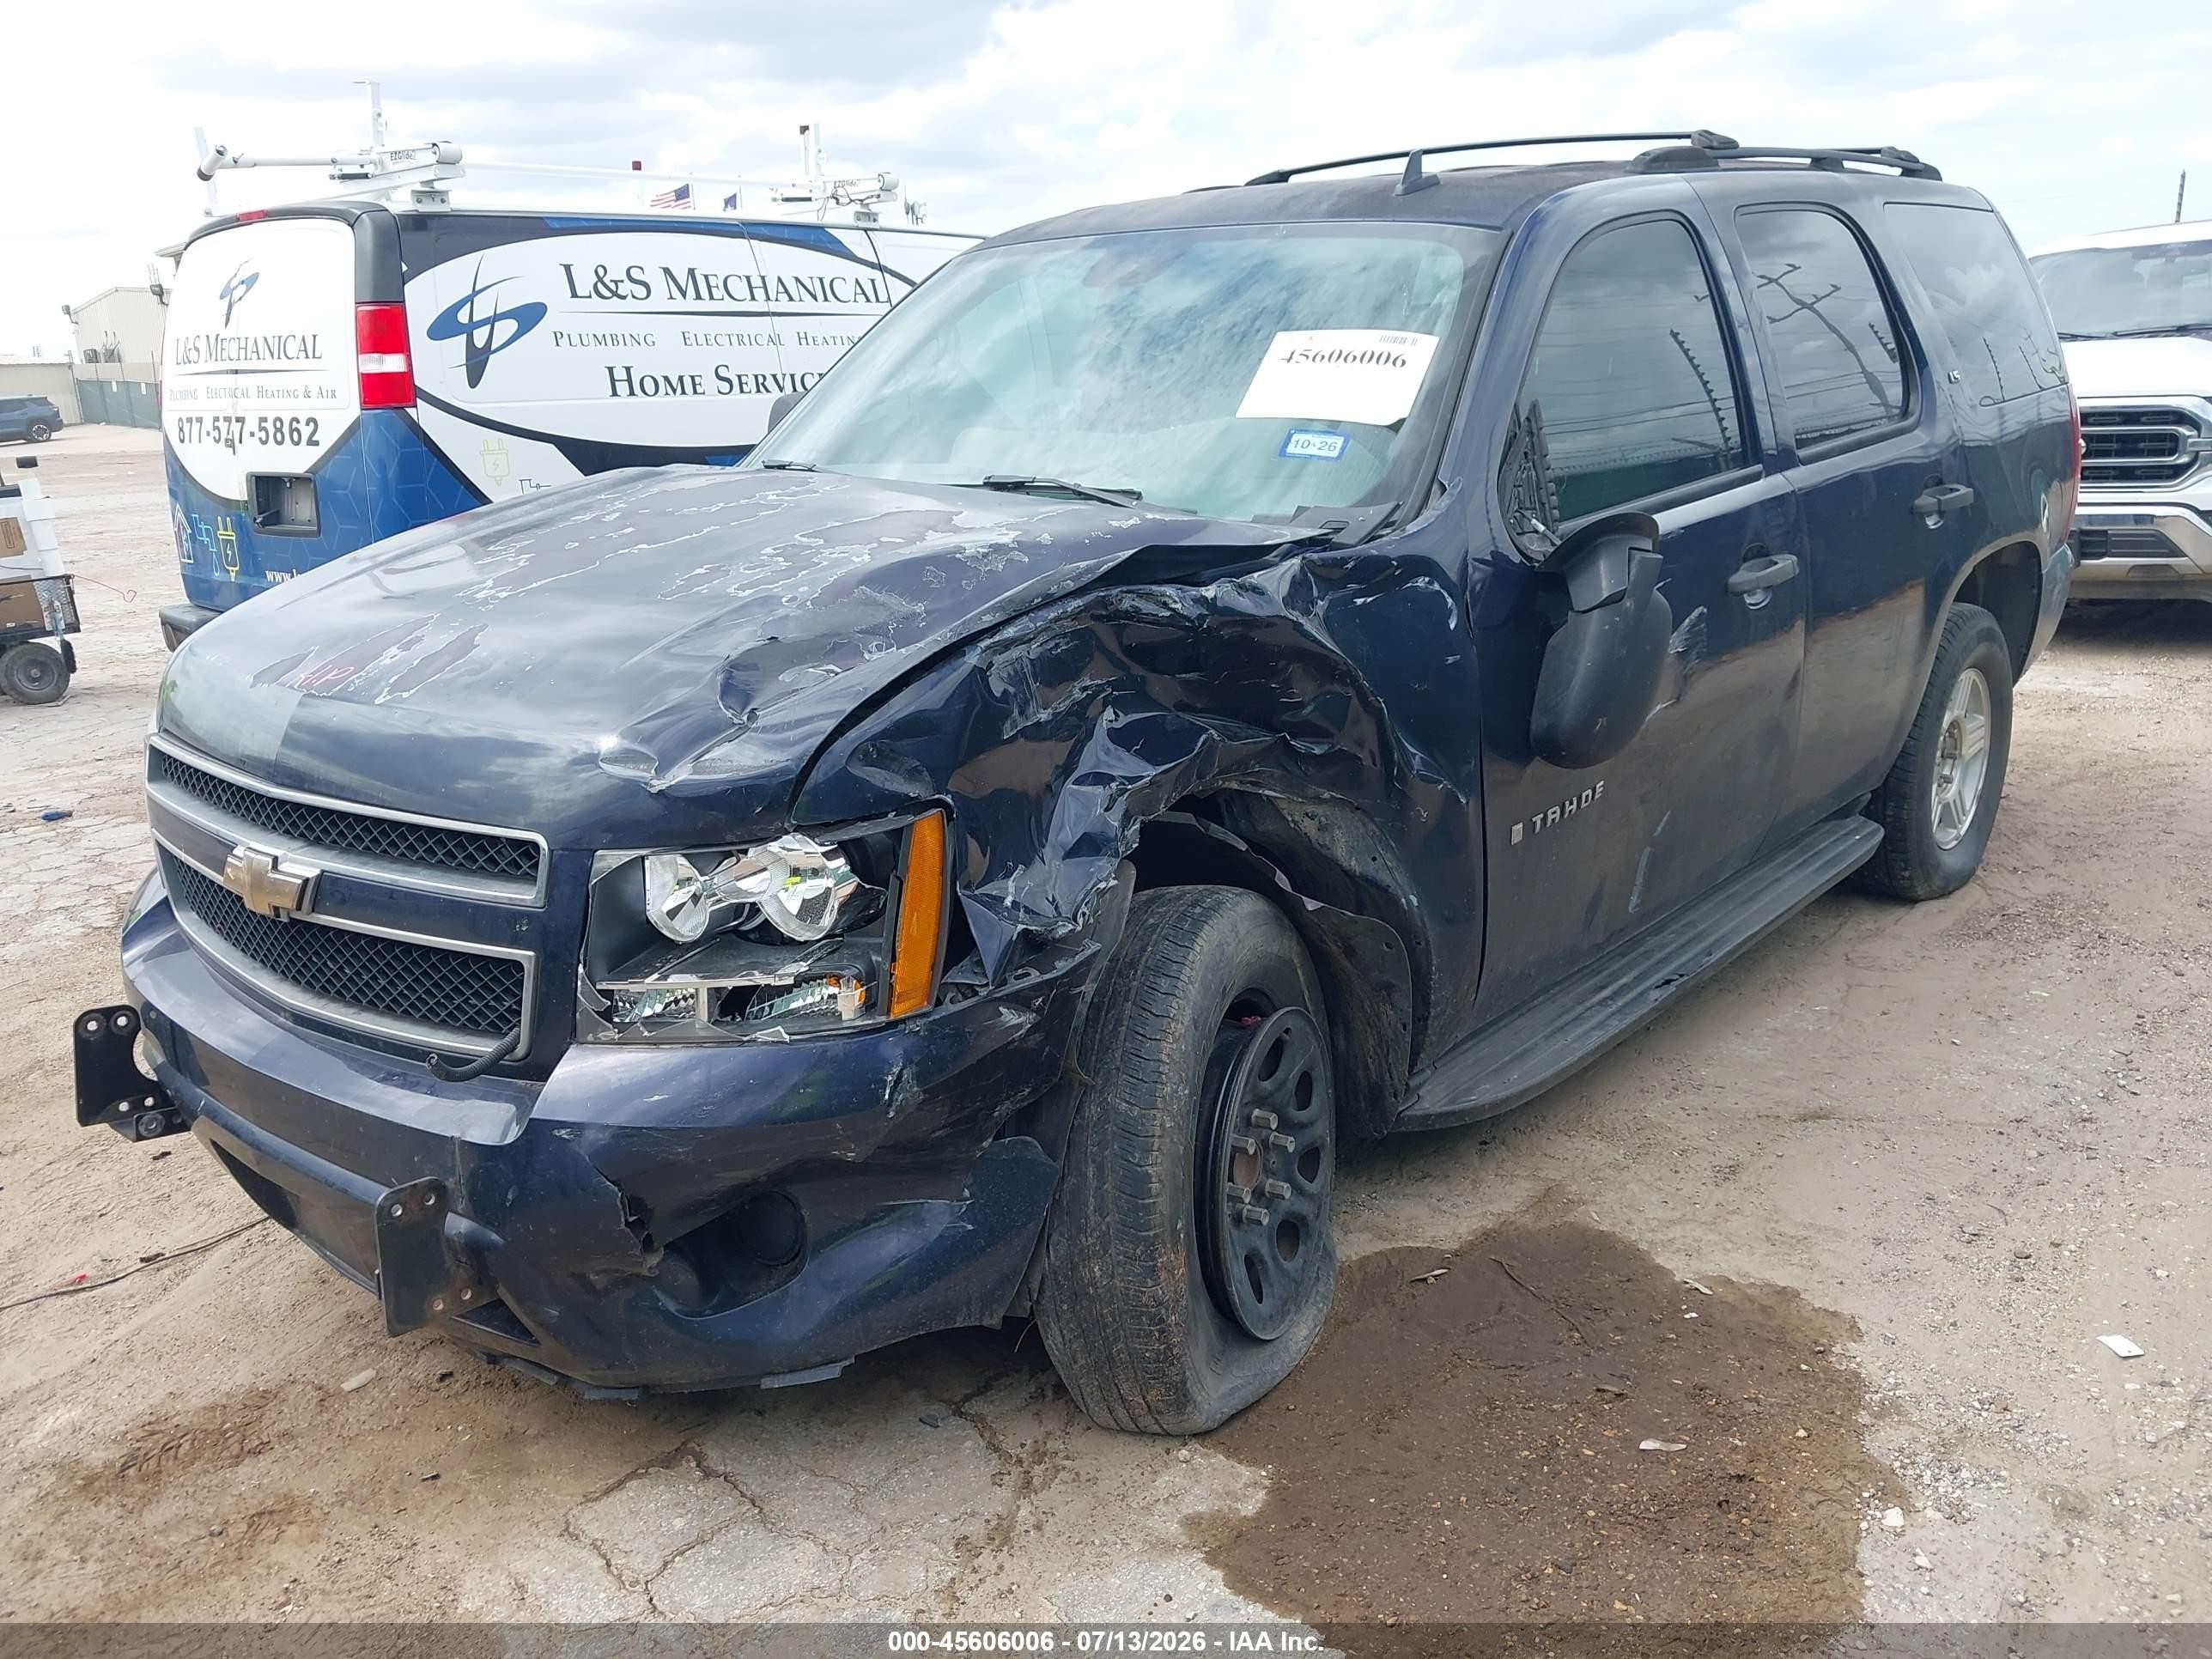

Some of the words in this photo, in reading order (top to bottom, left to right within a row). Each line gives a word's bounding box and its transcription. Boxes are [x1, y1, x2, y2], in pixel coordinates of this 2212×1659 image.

[559, 263, 652, 301] L&S
[659, 266, 890, 304] MECHANICAL
[175, 335, 200, 365] L&S
[204, 333, 323, 363] MECHANICAL
[552, 331, 656, 347] PLUMBING
[680, 331, 785, 347] ELECTRICAL
[796, 331, 861, 346] HEATIN
[1280, 349, 1407, 368] 45606006
[257, 385, 299, 399] HEATING
[303, 385, 312, 399] &
[317, 386, 337, 399] AIR
[605, 366, 705, 397] HOME
[178, 416, 319, 447] 877-577-5862
[1531, 780, 1604, 834] TAHOE
